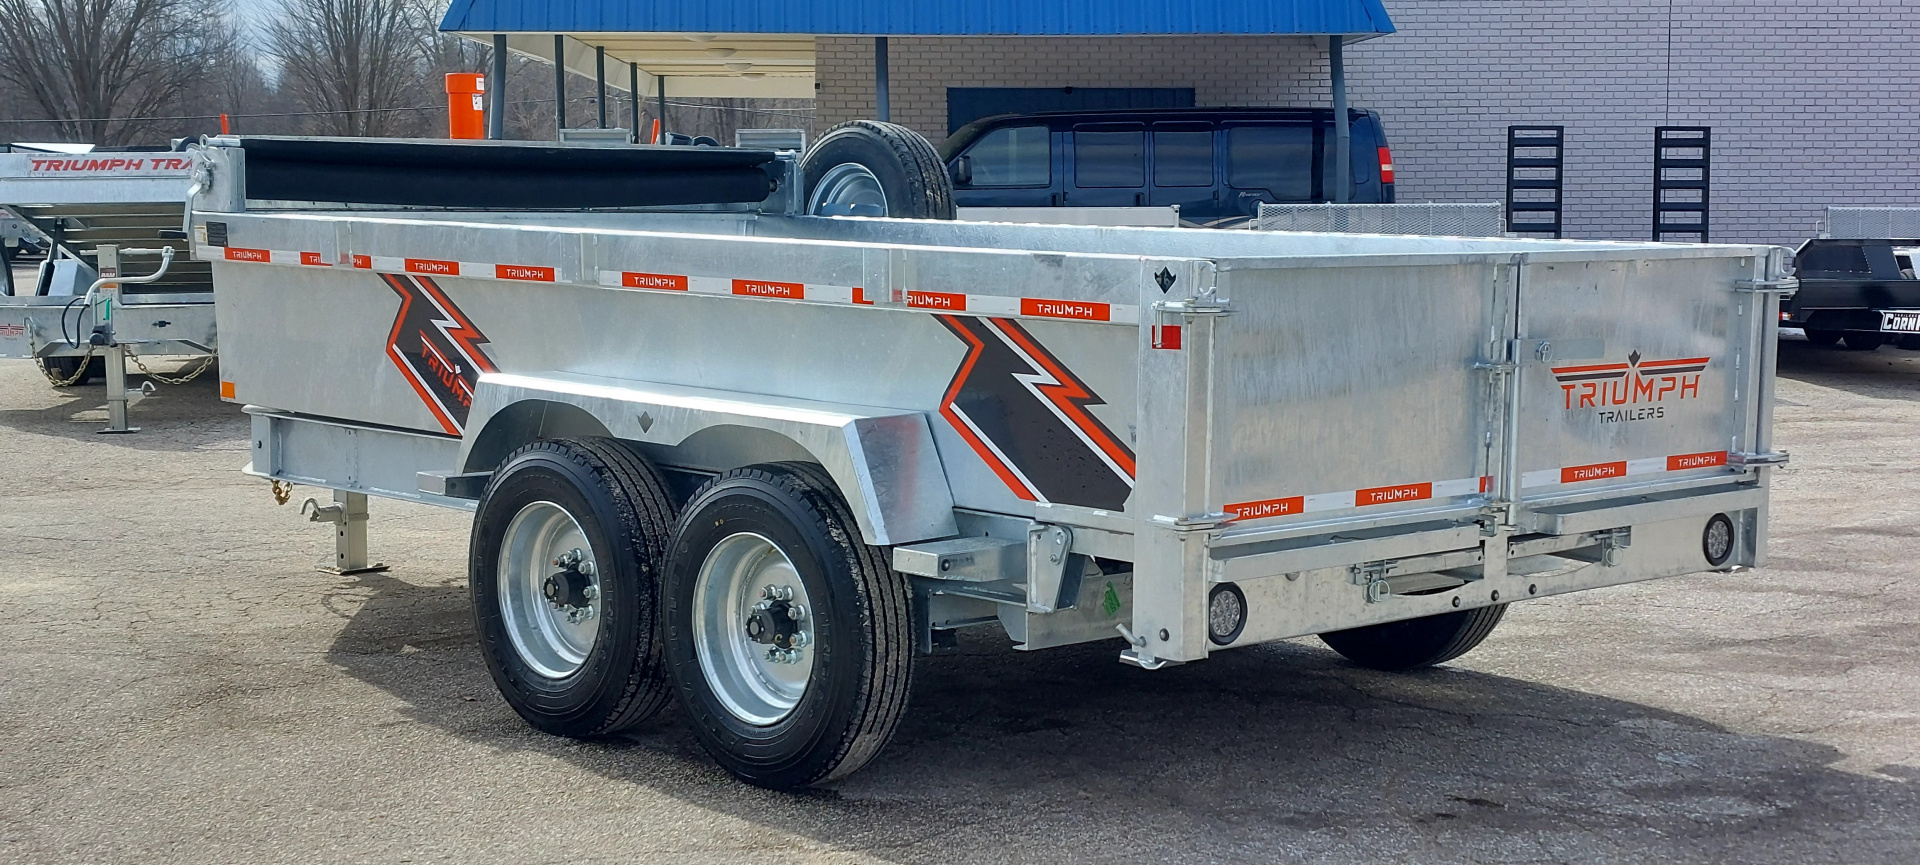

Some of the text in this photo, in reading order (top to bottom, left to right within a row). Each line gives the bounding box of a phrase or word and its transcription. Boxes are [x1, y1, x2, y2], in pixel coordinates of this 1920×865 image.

[31, 159, 144, 171] TRIUMPH
[232, 251, 262, 259] TRIUMPH
[414, 262, 449, 272] TRIUMPH
[506, 269, 544, 279] TRIUMPH
[633, 276, 676, 287] TRIUMPH
[745, 284, 790, 296] TRIUMPH
[906, 294, 951, 307] RIUMPH
[1037, 304, 1093, 317] TRIUMPH
[422, 342, 472, 407] TRIUMP
[1561, 372, 1700, 410] TRIUMPH
[1599, 407, 1664, 424] TRAILERS
[1678, 456, 1716, 467] TRIUMPH
[1574, 466, 1615, 479] TRIUMPH
[1370, 488, 1418, 502] TRIUMPH
[1236, 502, 1288, 518] TRIUMPH
